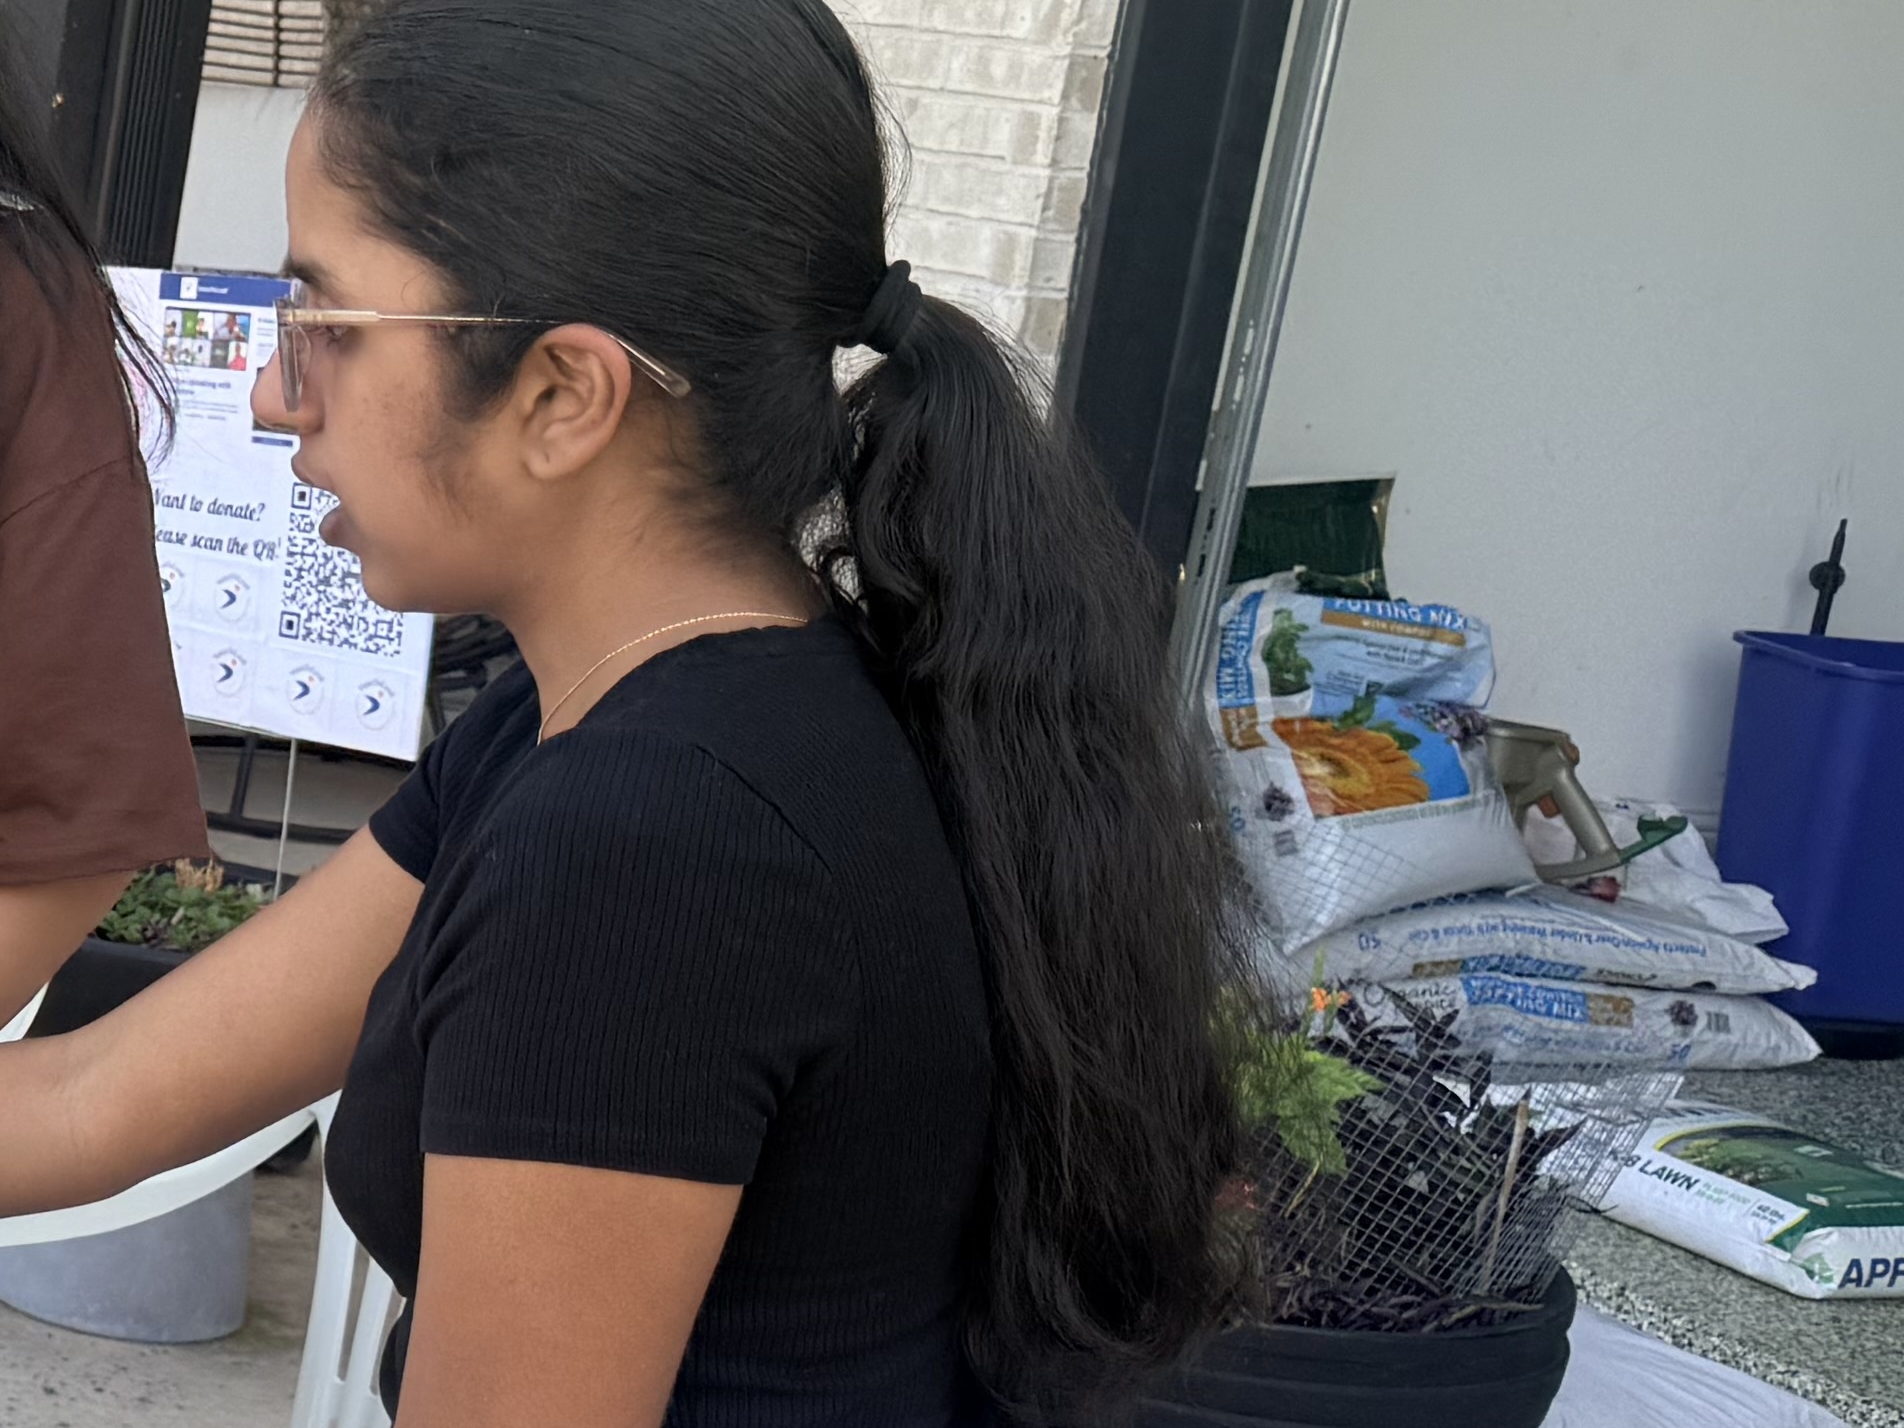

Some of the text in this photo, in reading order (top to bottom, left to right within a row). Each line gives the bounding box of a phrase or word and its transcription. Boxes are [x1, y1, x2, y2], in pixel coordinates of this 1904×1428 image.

[190, 495, 203, 512] to
[207, 497, 266, 521] donate?
[156, 527, 188, 546] ease
[190, 532, 224, 552] scan
[226, 537, 249, 556] the
[1431, 609, 1466, 631] MIX
[1552, 1000, 1584, 1019] MIX
[1638, 1159, 1700, 1192] LAWN
